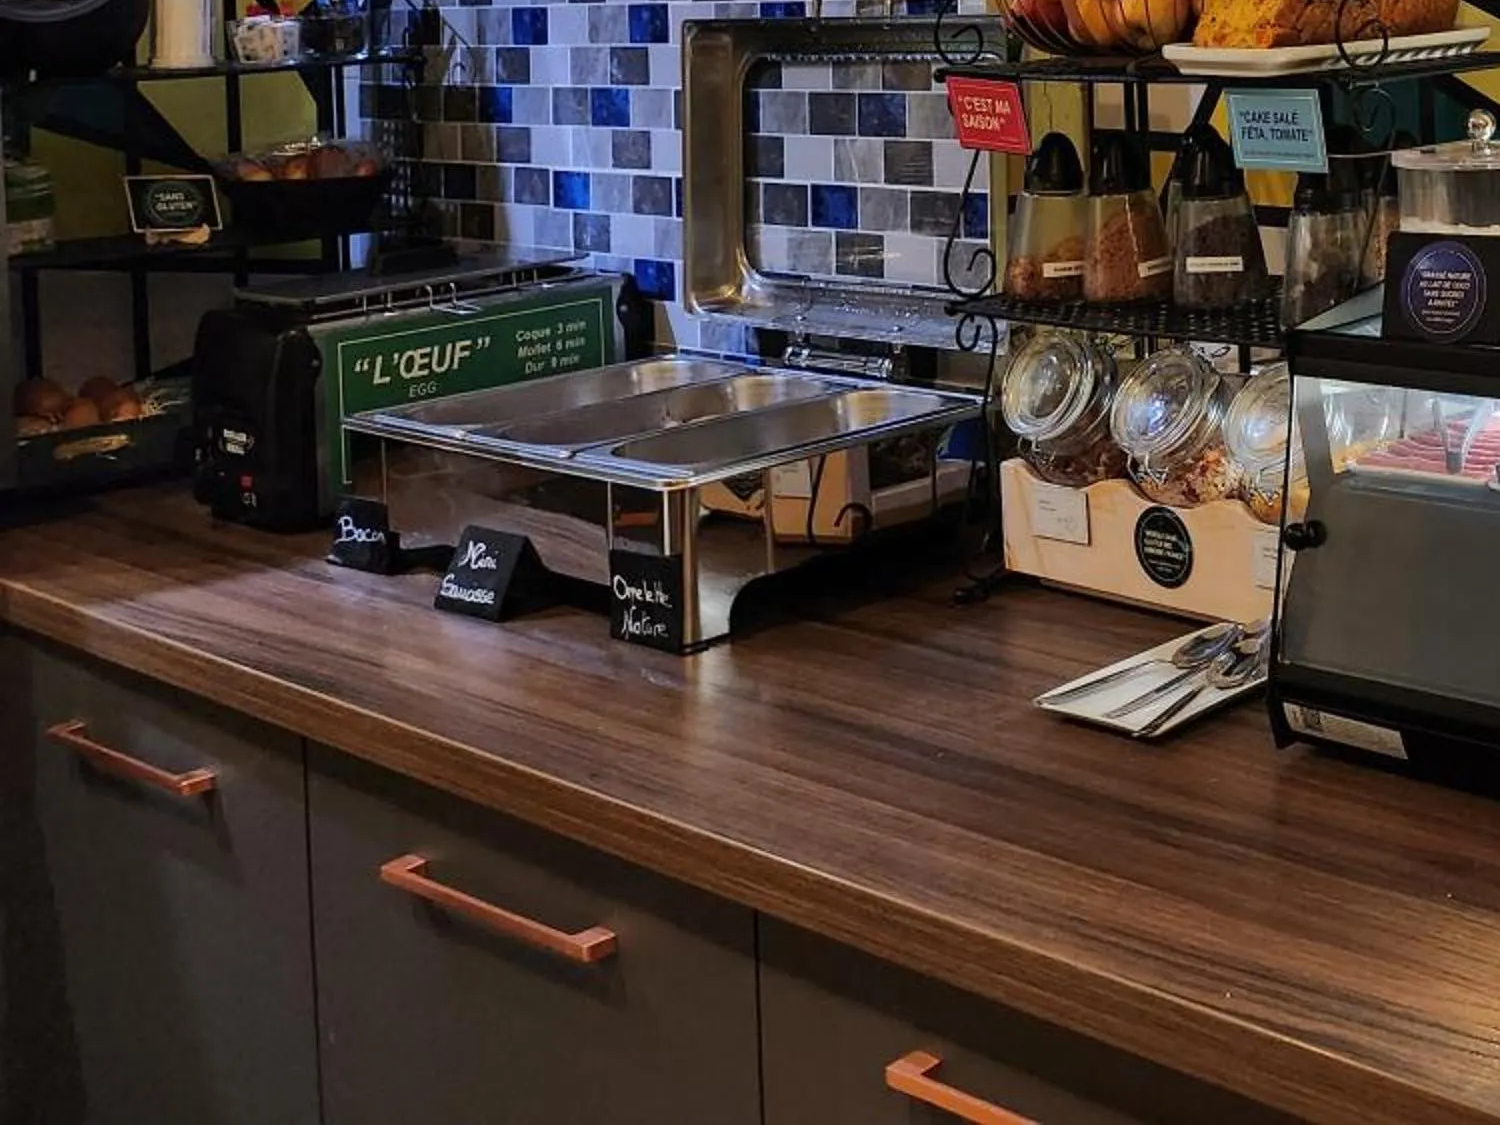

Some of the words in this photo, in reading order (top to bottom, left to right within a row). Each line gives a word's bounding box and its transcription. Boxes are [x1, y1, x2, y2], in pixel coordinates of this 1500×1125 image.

[995, 99, 1011, 114] MA
[1273, 109, 1299, 125] SALÉ
[516, 326, 551, 343] Coque
[557, 322, 564, 335] 3
[565, 319, 586, 333] min
[565, 335, 586, 349] min
[525, 358, 545, 375] Dur
[408, 380, 437, 398] EGG
